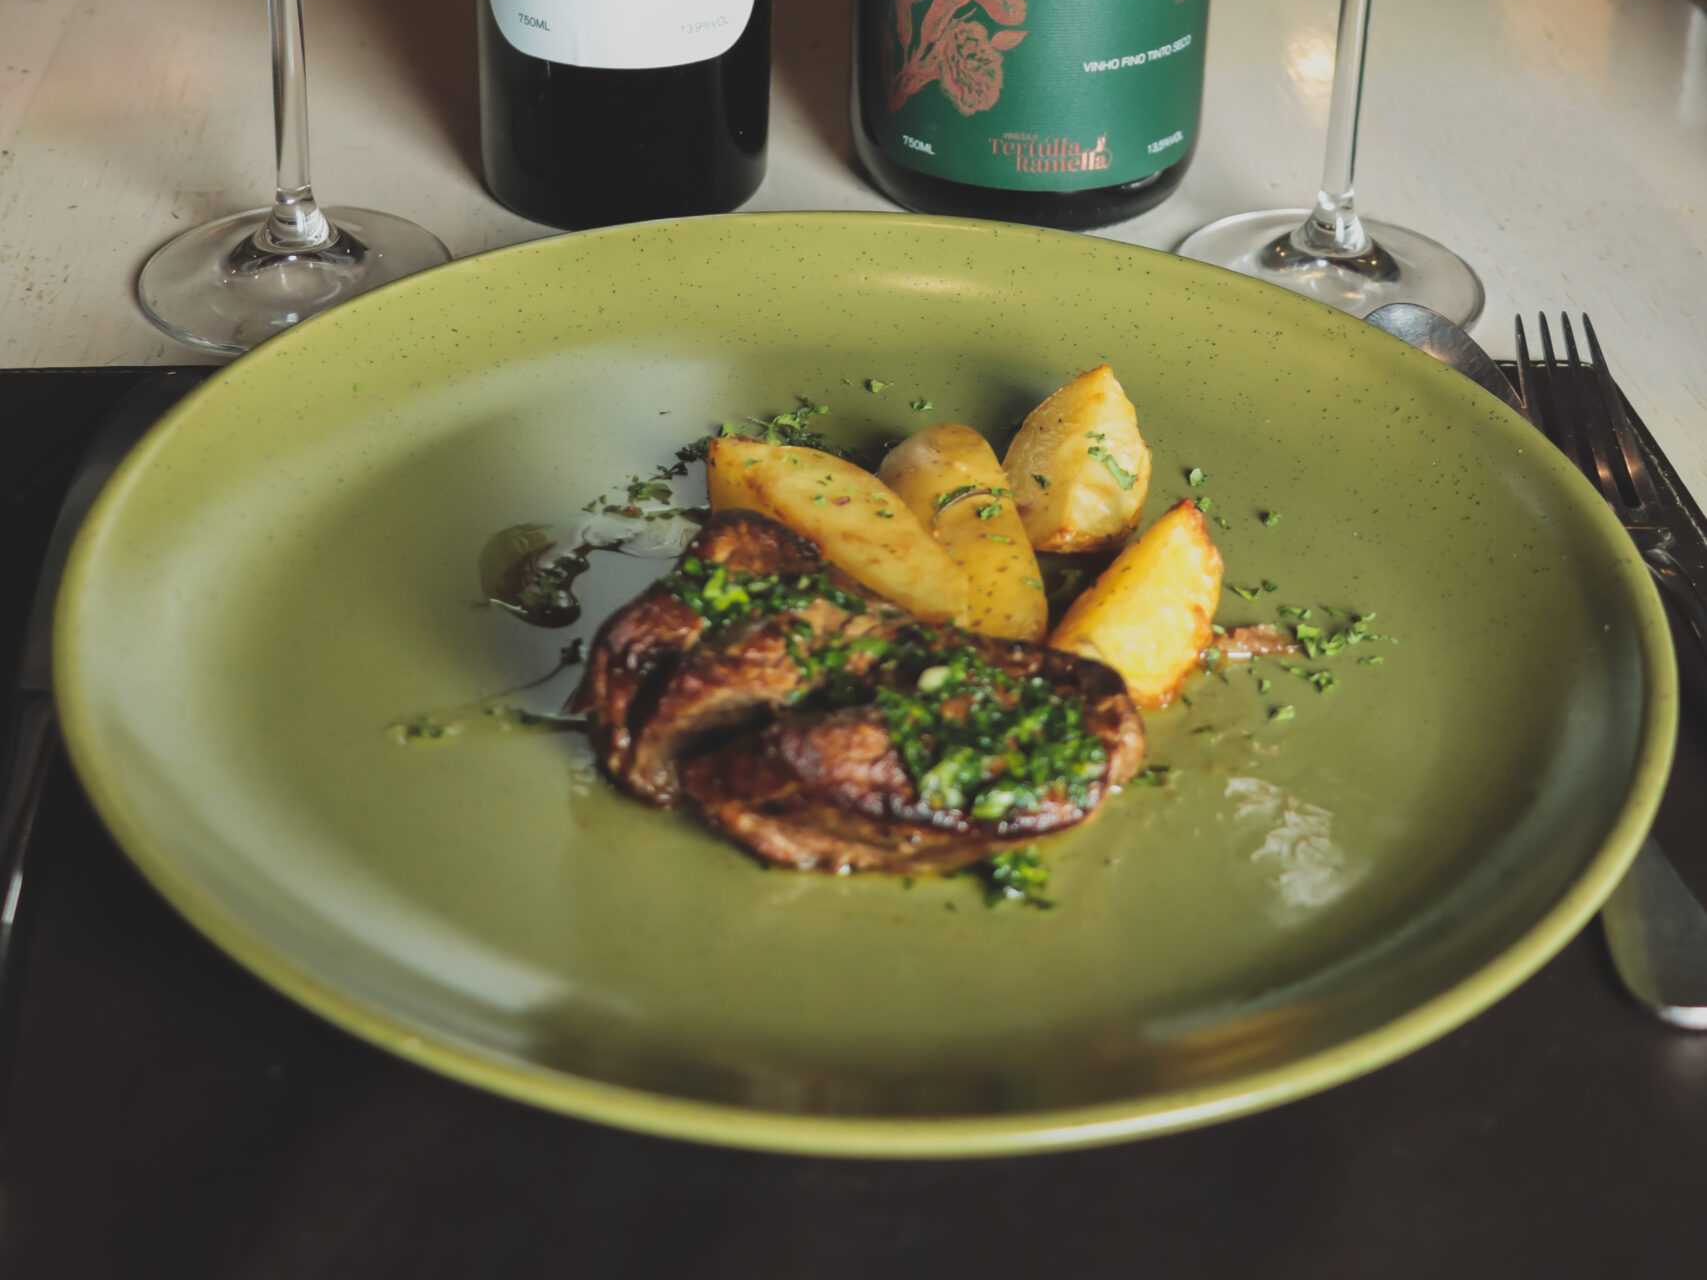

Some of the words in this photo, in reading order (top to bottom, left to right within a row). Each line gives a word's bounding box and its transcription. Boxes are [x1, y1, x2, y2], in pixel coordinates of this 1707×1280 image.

[518, 13, 551, 31] 750ML
[1083, 58, 1120, 72] VINHO
[1121, 53, 1146, 68] FINO
[1147, 44, 1172, 61] TINTO
[1172, 34, 1192, 53] SECO
[902, 134, 936, 155] 750ML
[988, 136, 1081, 156] Tertúlia
[1016, 151, 1108, 172] Ramella
